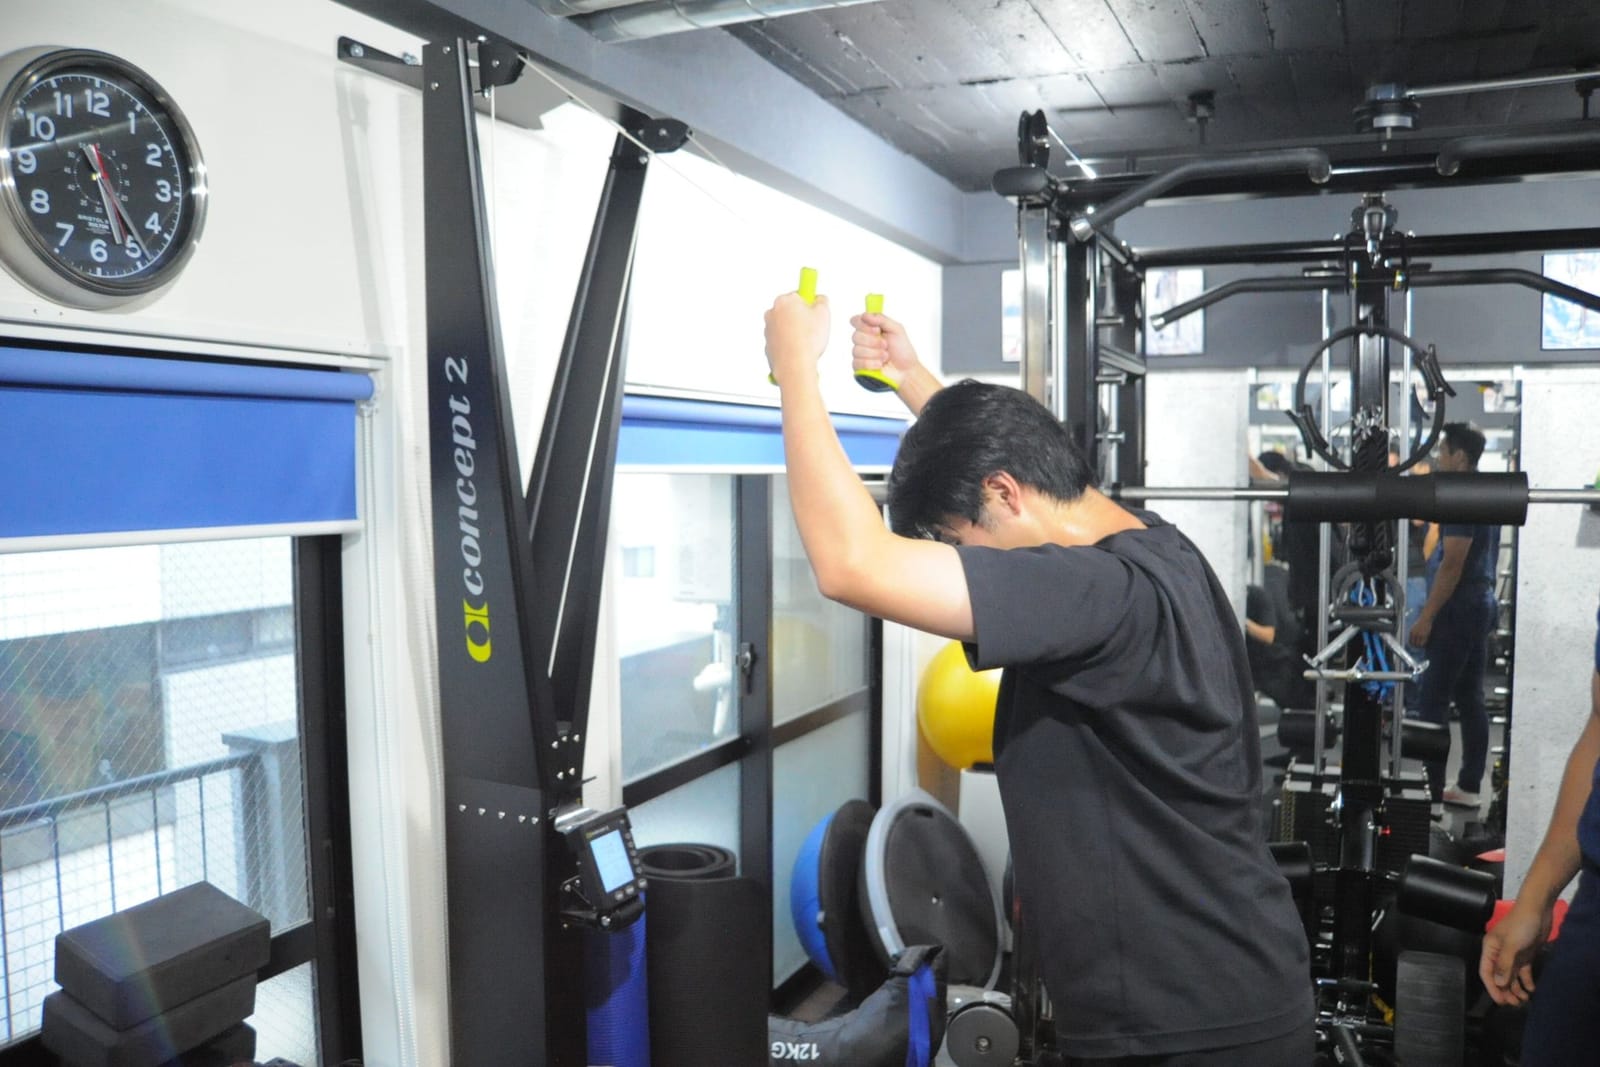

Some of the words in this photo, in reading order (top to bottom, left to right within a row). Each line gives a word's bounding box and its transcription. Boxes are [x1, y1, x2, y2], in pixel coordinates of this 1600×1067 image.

[53, 91, 73, 118] 11
[84, 88, 111, 118] 12
[26, 111, 56, 141] 10
[127, 111, 136, 135] 1
[17, 149, 37, 174] 9
[146, 143, 163, 168] 2
[30, 188, 50, 214] 8
[155, 179, 172, 203] 3
[55, 222, 75, 247] 7
[144, 212, 162, 235] 4
[89, 238, 108, 263] 6
[125, 234, 142, 259] 5
[445, 356, 468, 384] 2
[449, 395, 484, 596] concept
[771, 1041, 820, 1060] 12KG
